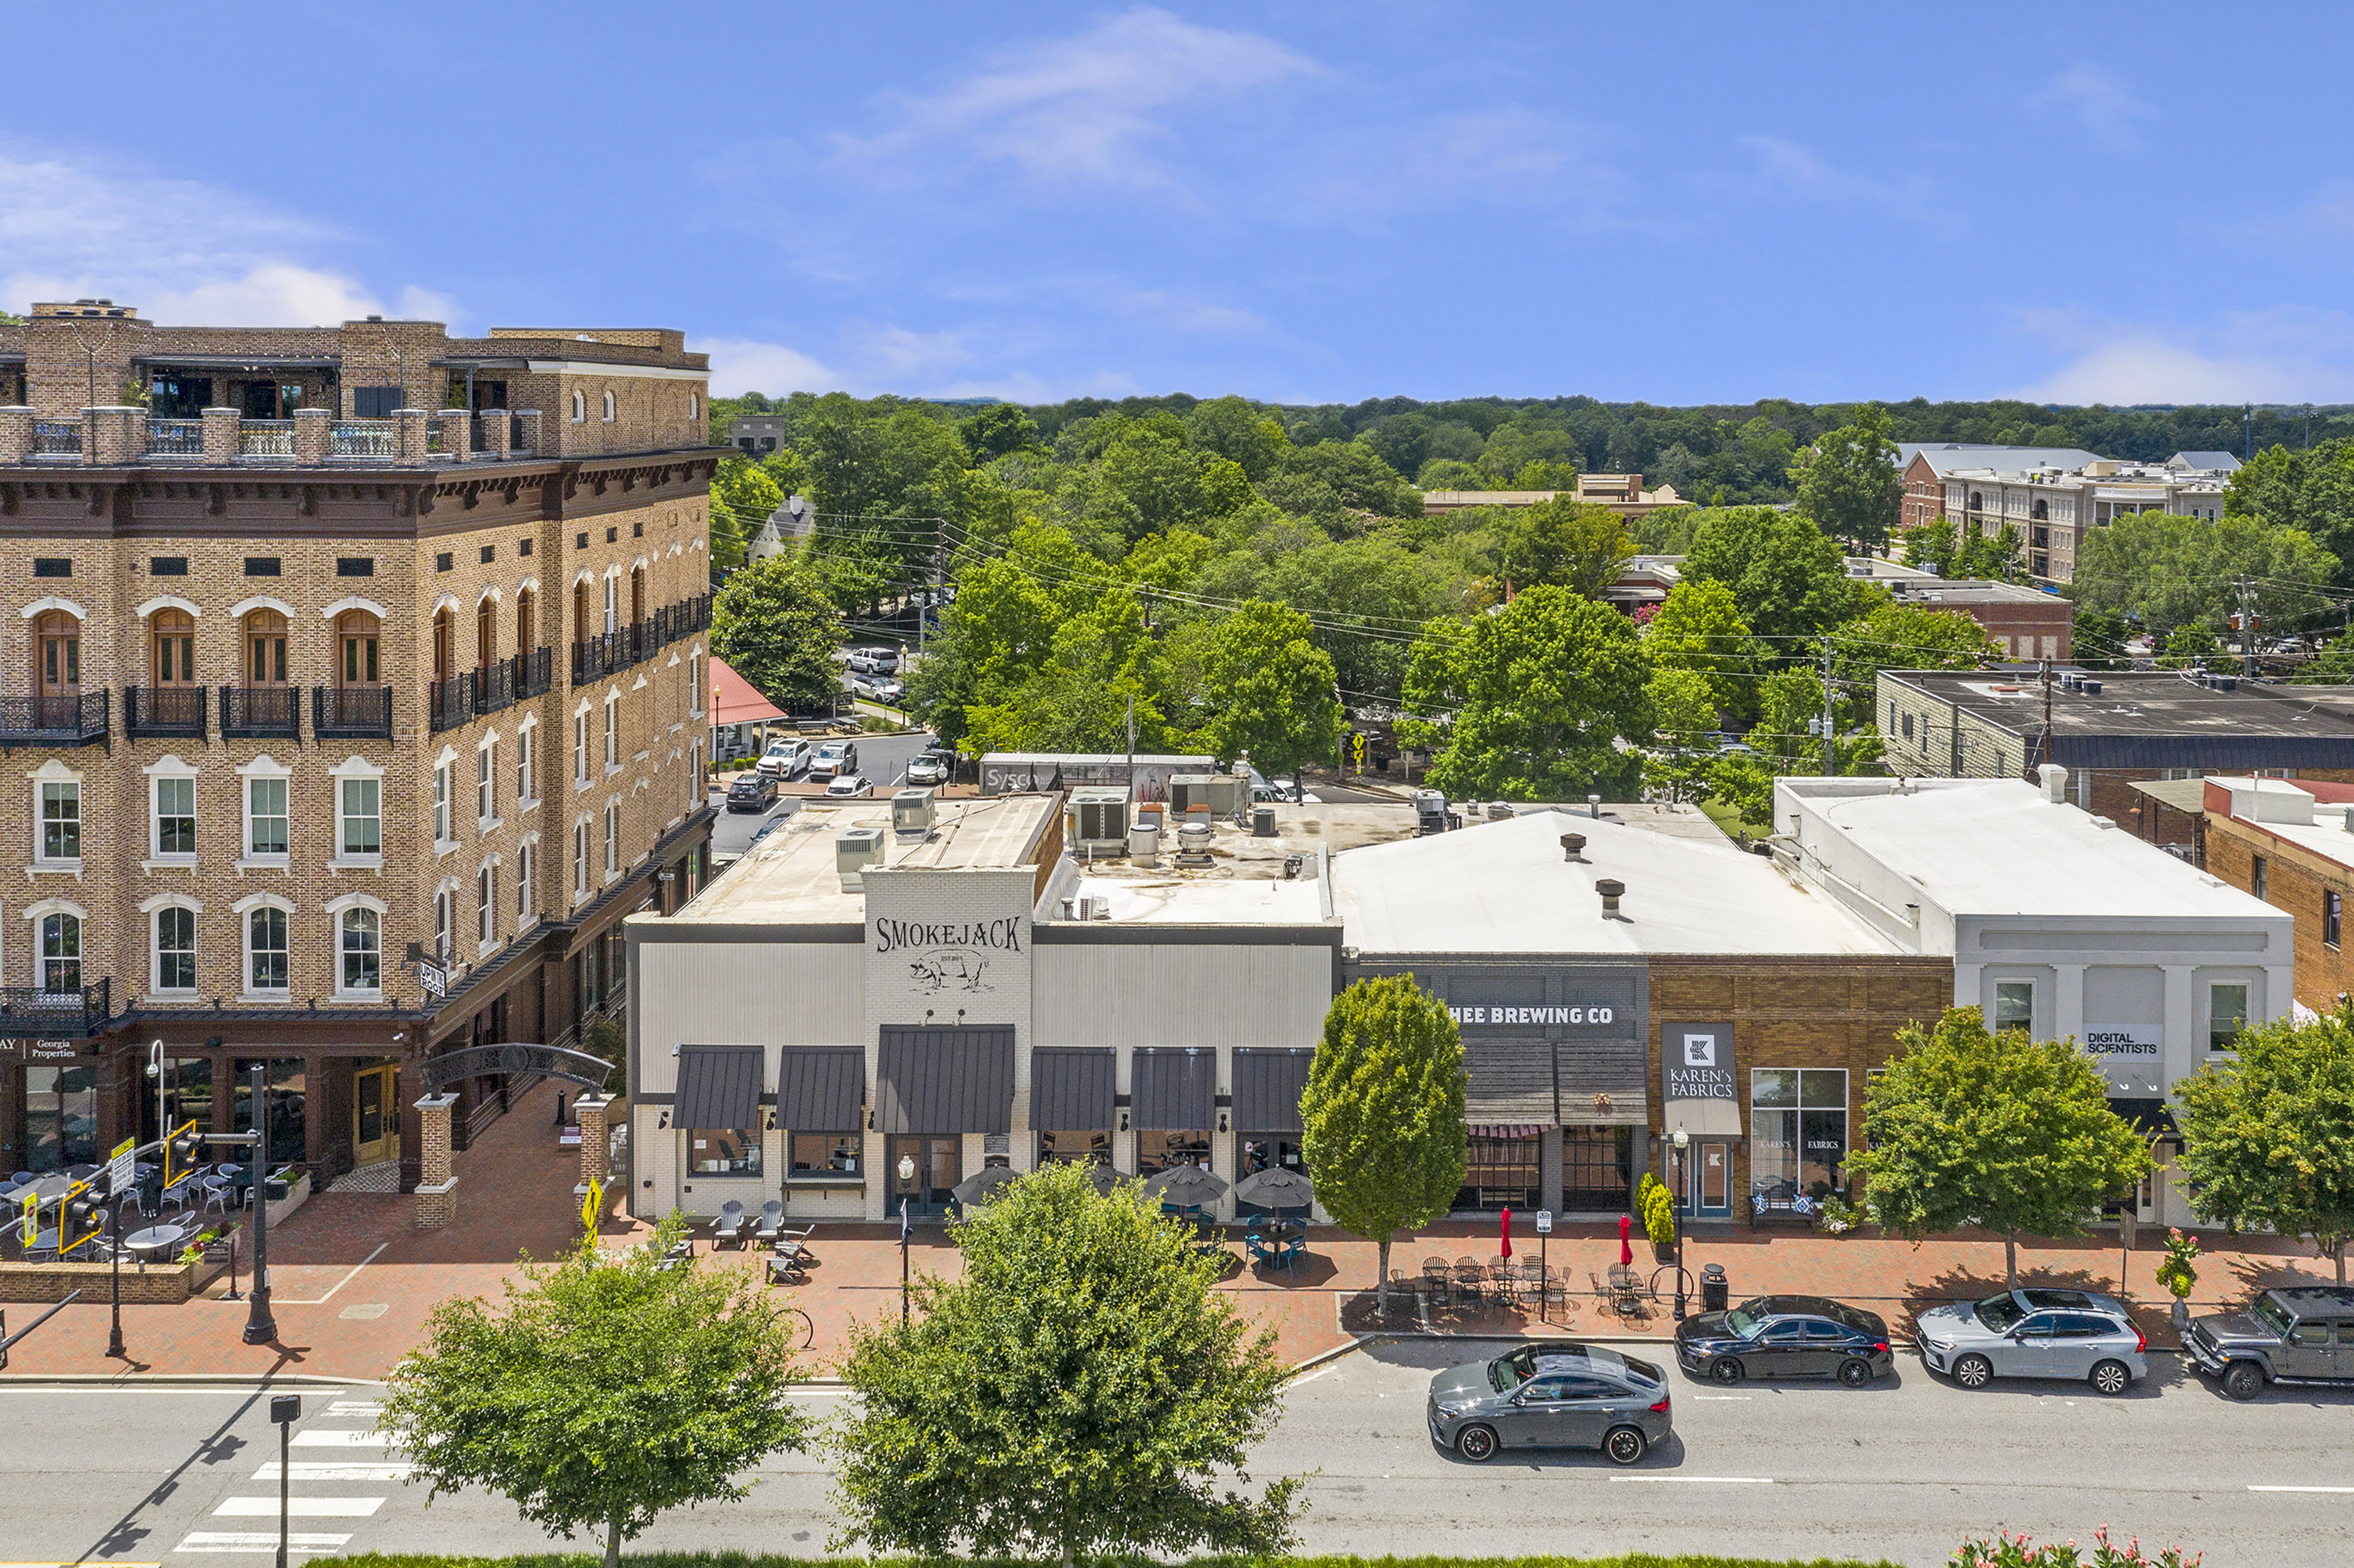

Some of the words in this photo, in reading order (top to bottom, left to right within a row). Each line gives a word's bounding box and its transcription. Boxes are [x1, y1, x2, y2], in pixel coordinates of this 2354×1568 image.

[988, 769, 1039, 790] Sysco
[877, 916, 1022, 953] SMOKEJACK
[421, 977, 444, 994] ROOF
[1491, 1007, 1582, 1023] BREWING
[1588, 1007, 1612, 1023] CO
[37, 1040, 70, 1048] Georgia
[2088, 1033, 2134, 1043] DIGITAL
[32, 1049, 76, 1059] Properties
[2088, 1043, 2157, 1053] SCIENTISTS
[1671, 1083, 1732, 1097] FABRICS
